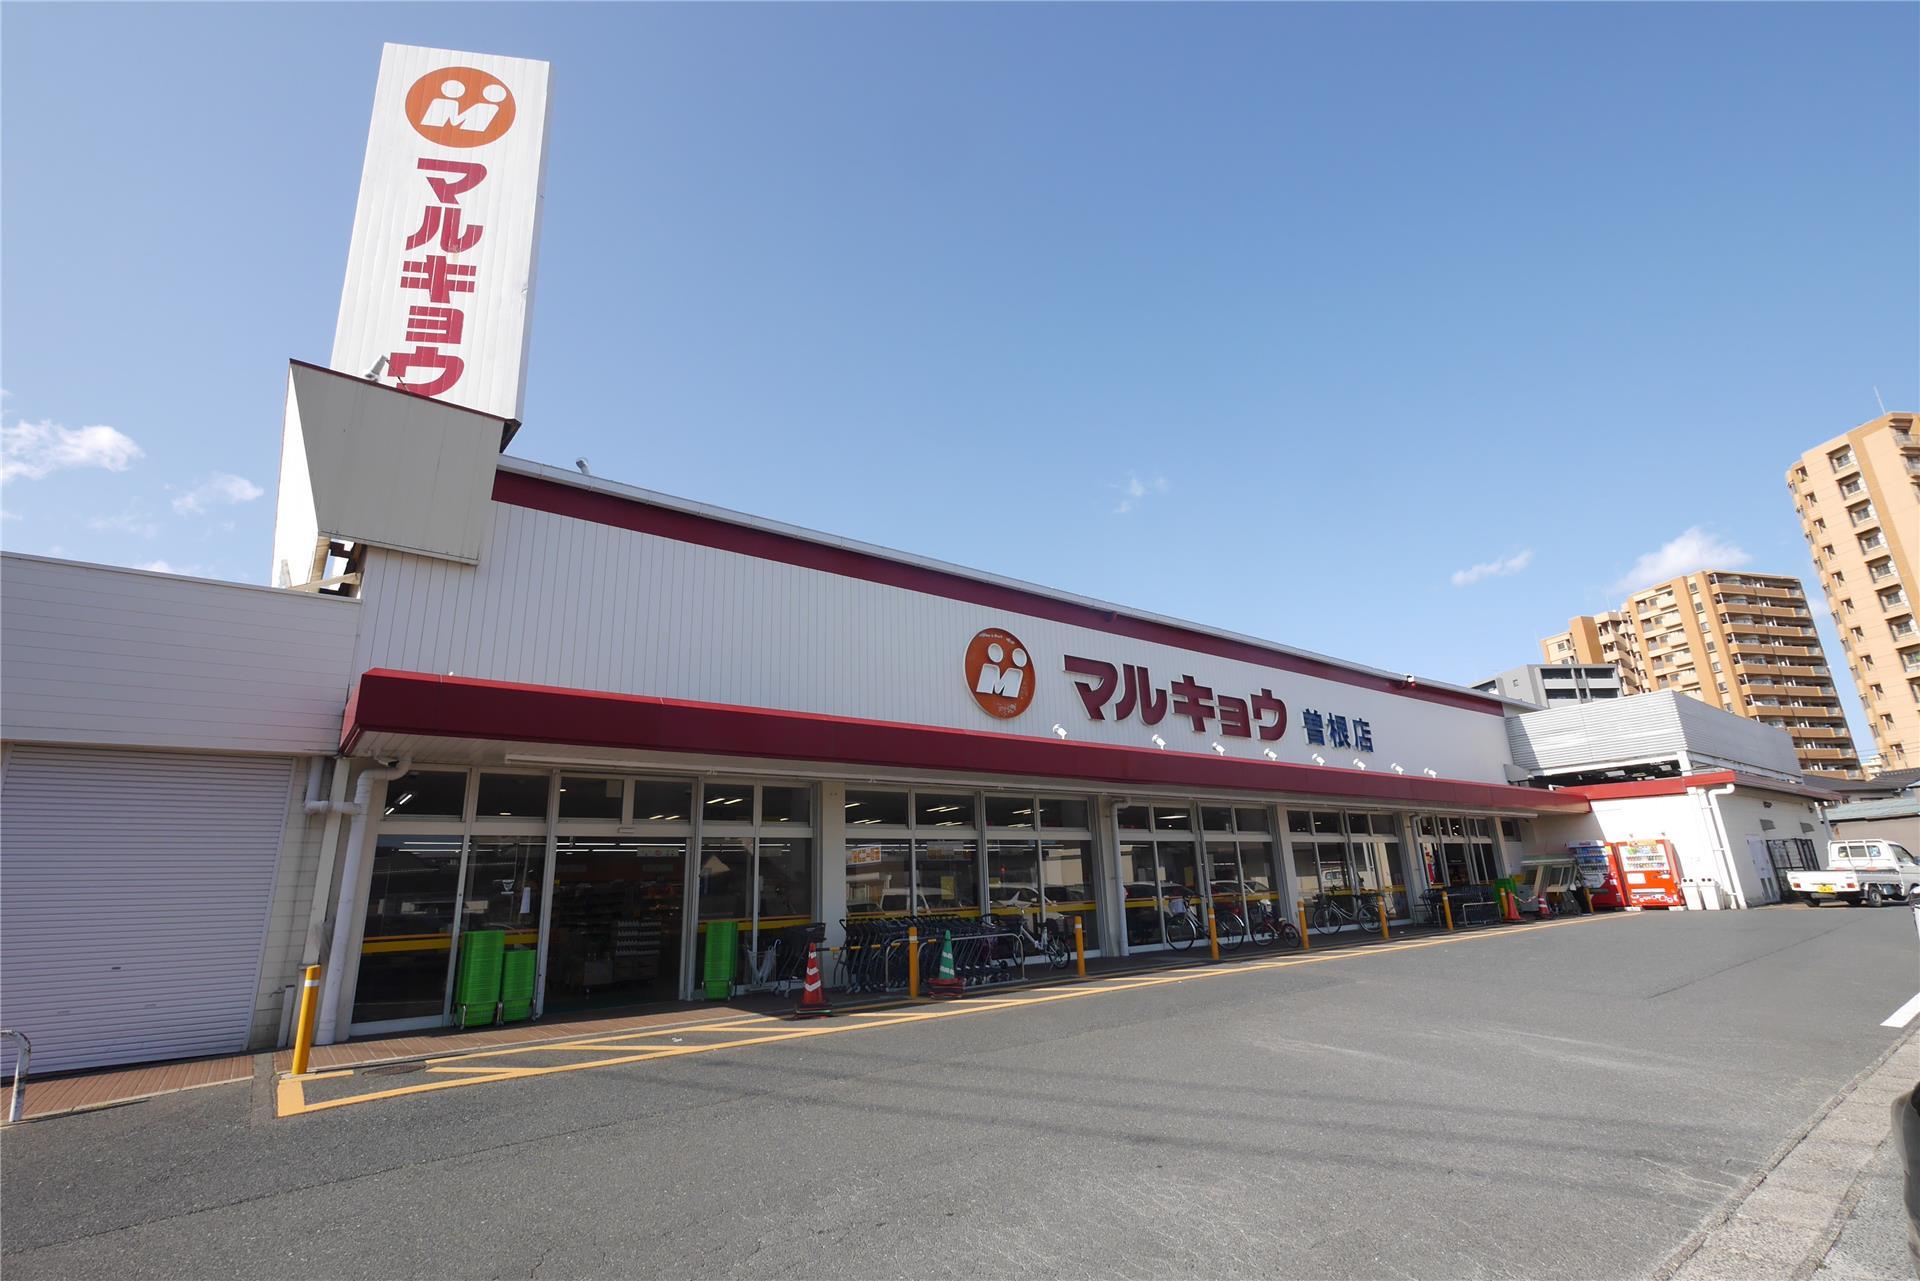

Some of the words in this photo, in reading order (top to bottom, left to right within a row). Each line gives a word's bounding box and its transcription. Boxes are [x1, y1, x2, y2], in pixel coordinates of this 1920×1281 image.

[387, 157, 488, 398] マルキョウ
[1064, 654, 1287, 742] マルキョウ
